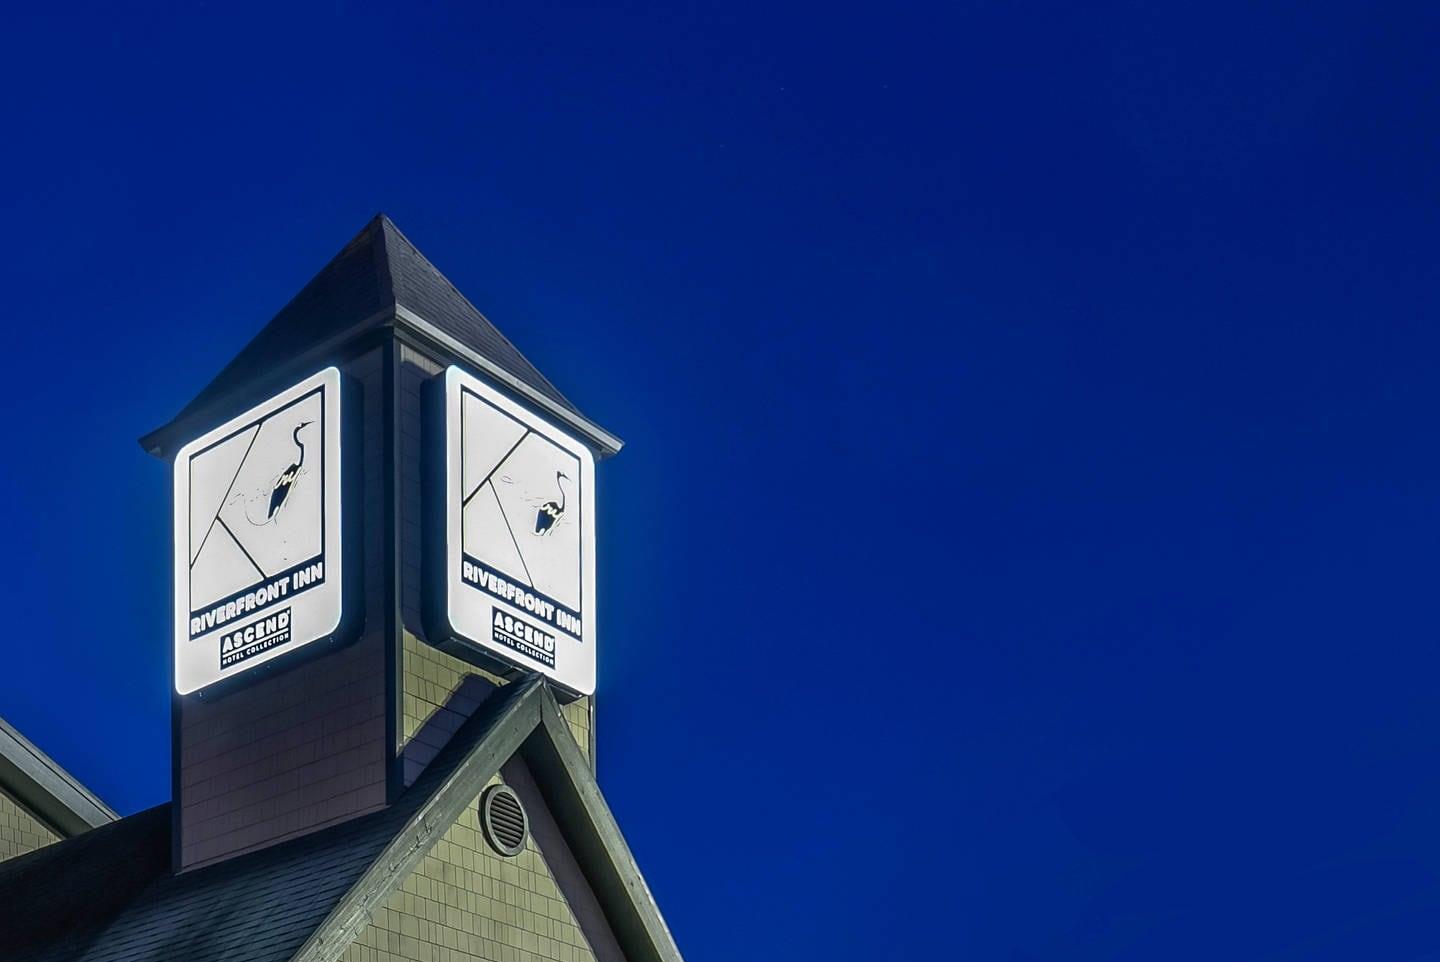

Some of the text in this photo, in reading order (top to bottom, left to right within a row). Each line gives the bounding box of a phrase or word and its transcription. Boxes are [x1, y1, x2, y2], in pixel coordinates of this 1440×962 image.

[190, 562, 323, 635] RIVERFRONT INN
[463, 561, 581, 636] RIVERFRONT INN
[222, 611, 290, 653] ASCEND
[222, 633, 289, 665] HOTEL COLLECTION
[494, 612, 555, 652] ASCEND
[494, 632, 554, 665] HOTEL COLLECTION
